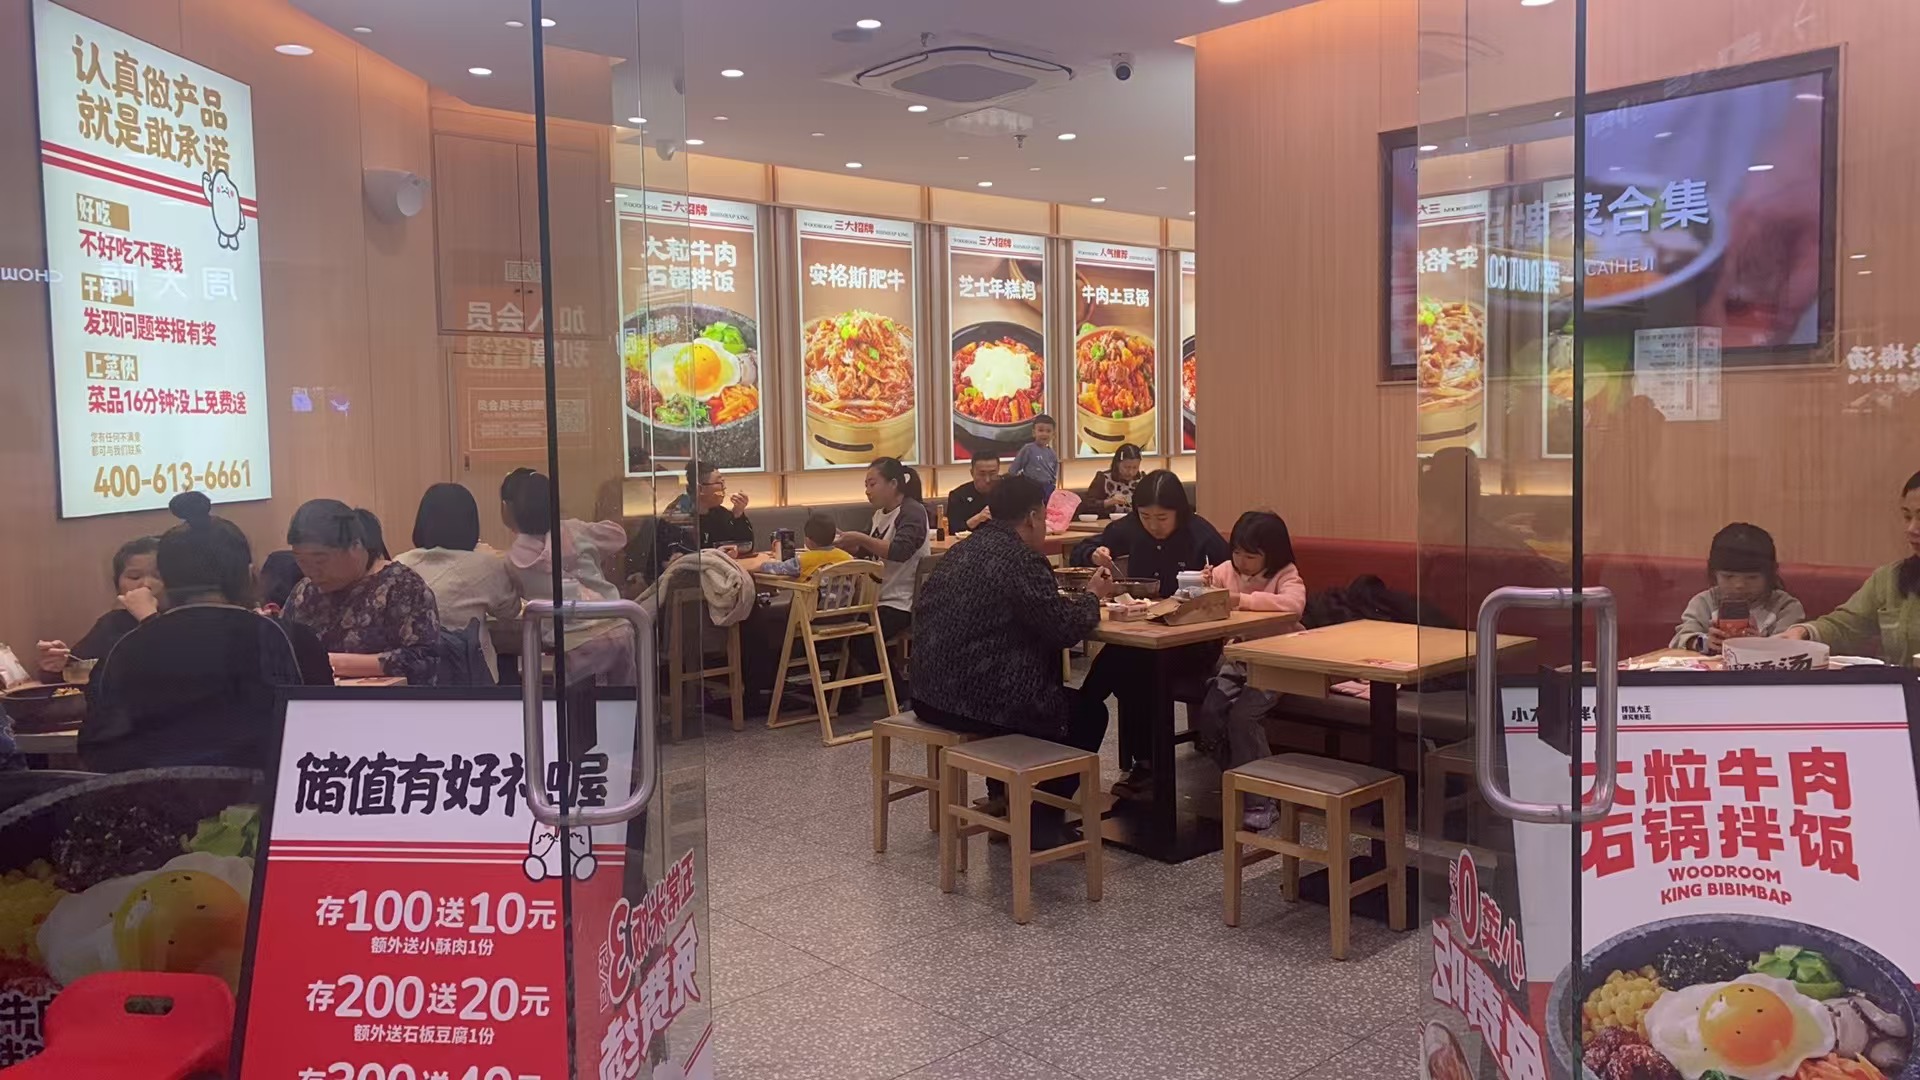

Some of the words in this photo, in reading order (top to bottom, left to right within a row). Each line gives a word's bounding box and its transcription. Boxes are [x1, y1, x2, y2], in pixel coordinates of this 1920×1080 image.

[72, 34, 228, 131] 认真做产品
[76, 89, 230, 175] 就是敢承诺
[78, 197, 112, 226] 好吃
[661, 199, 708, 217] 三大招牌
[834, 219, 875, 235] 三大招牌
[79, 229, 184, 273] 不好吃不要钱
[641, 234, 737, 268] 大粒牛肉
[979, 235, 1012, 249] 三大招牌
[646, 265, 735, 293] 石锅拌饭
[809, 262, 905, 292] 安格斯肥牛
[958, 275, 1037, 301] 芝士年糕鸡
[1081, 284, 1150, 307] 牛肉土豆锅
[83, 307, 217, 346] 发现问题举报有奖
[89, 353, 137, 380] 上菜快
[88, 385, 248, 415] 菜品16分钟没上免费送
[91, 432, 141, 443] 您有任何不满意
[91, 445, 143, 457] 都可与我们联系
[93, 459, 251, 498] 400-613-6661
[1569, 746, 1852, 810] 大粒牛肉
[1581, 805, 1860, 881] 石锅拌饭
[1668, 864, 1781, 885] WOODROOM
[1660, 882, 1702, 905] KING
[1708, 883, 1792, 906] BIBIMBAP
[315, 889, 557, 935] 存100送10元
[370, 937, 494, 957] 额外送小酥肉1份
[305, 974, 550, 1021] 存200送20元
[353, 1024, 495, 1046] 额外送石板豆腐1份
